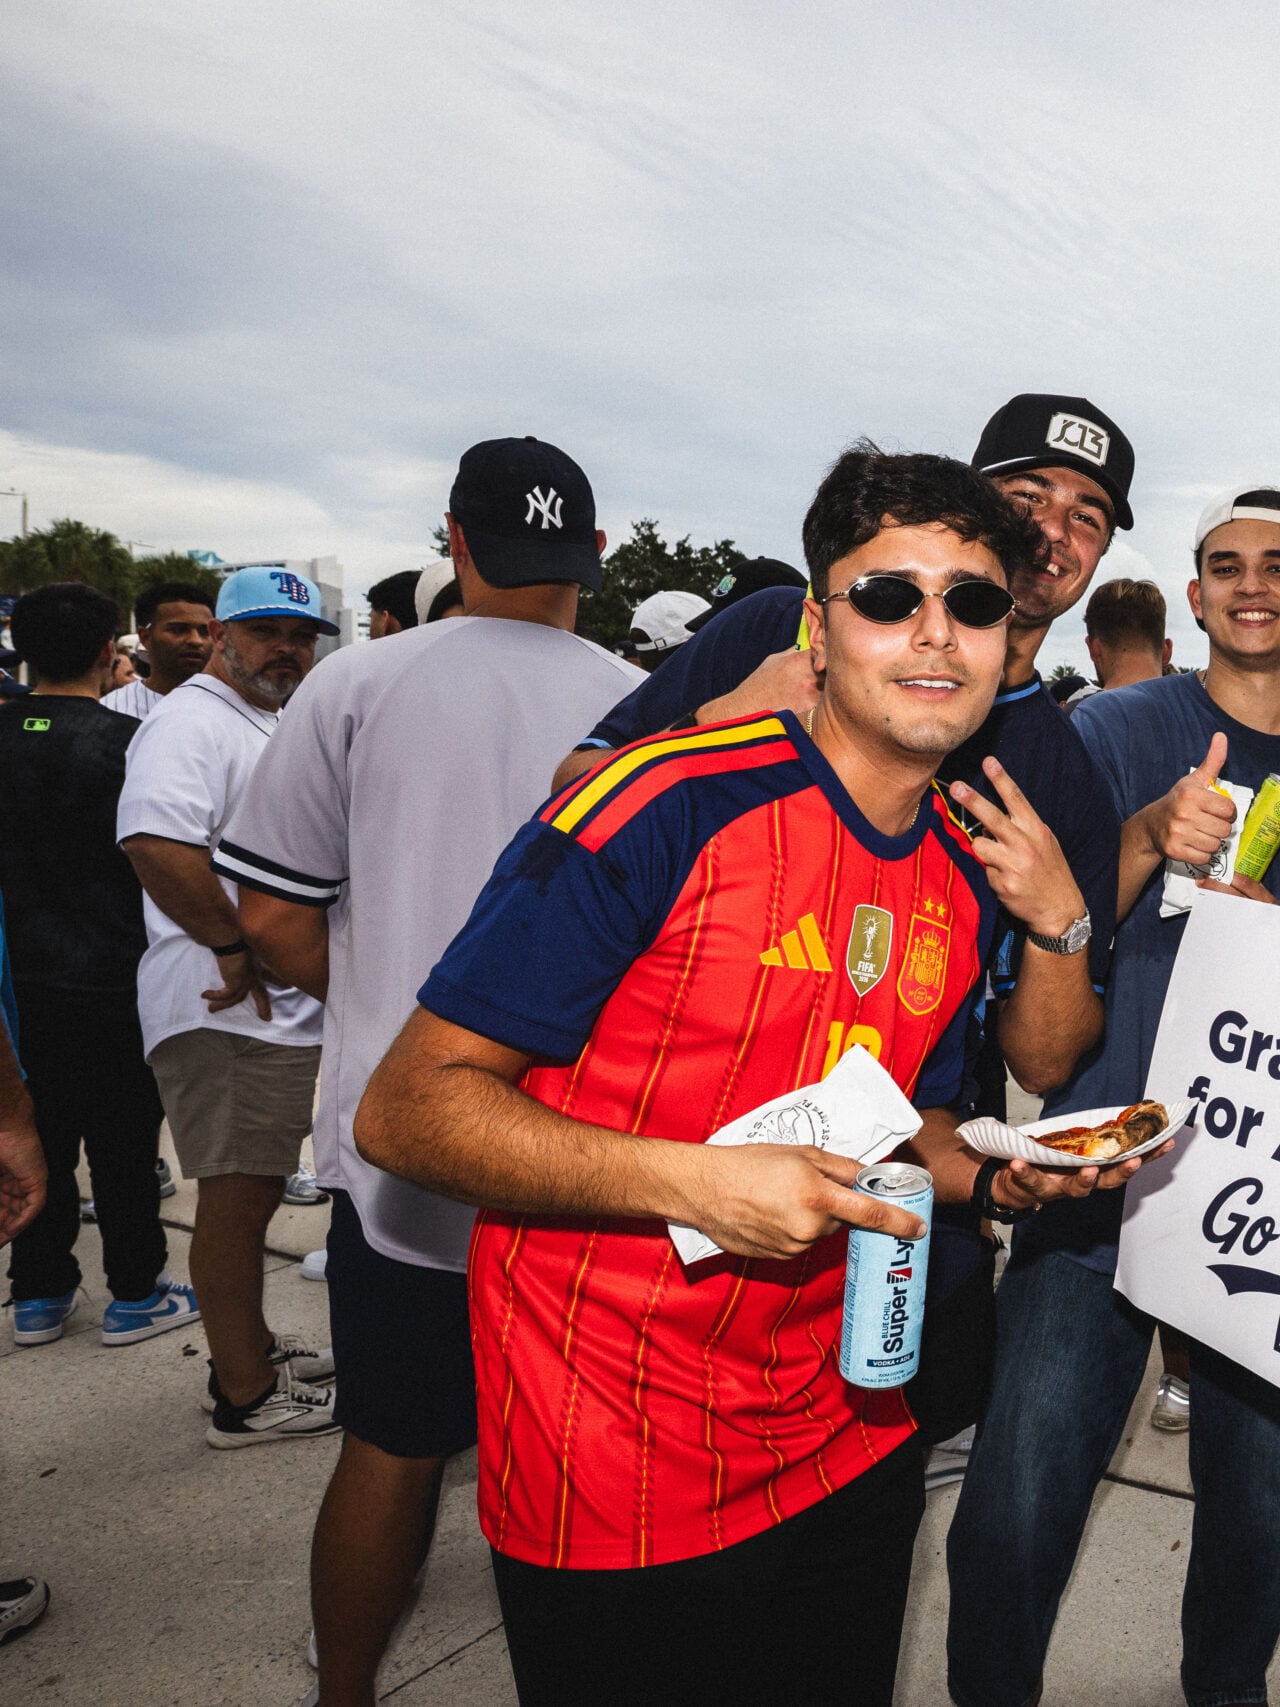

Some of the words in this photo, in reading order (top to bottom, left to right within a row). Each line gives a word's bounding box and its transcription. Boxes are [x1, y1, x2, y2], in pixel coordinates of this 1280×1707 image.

[524, 485, 564, 529] NY
[269, 572, 310, 605] TB
[1184, 1075, 1264, 1148] for
[1201, 1177, 1280, 1256] Go
[889, 1236, 914, 1267] Ly
[882, 1286, 909, 1354] Super
[883, 1301, 891, 1320] CHILL
[881, 1321, 890, 1339] BLUE
